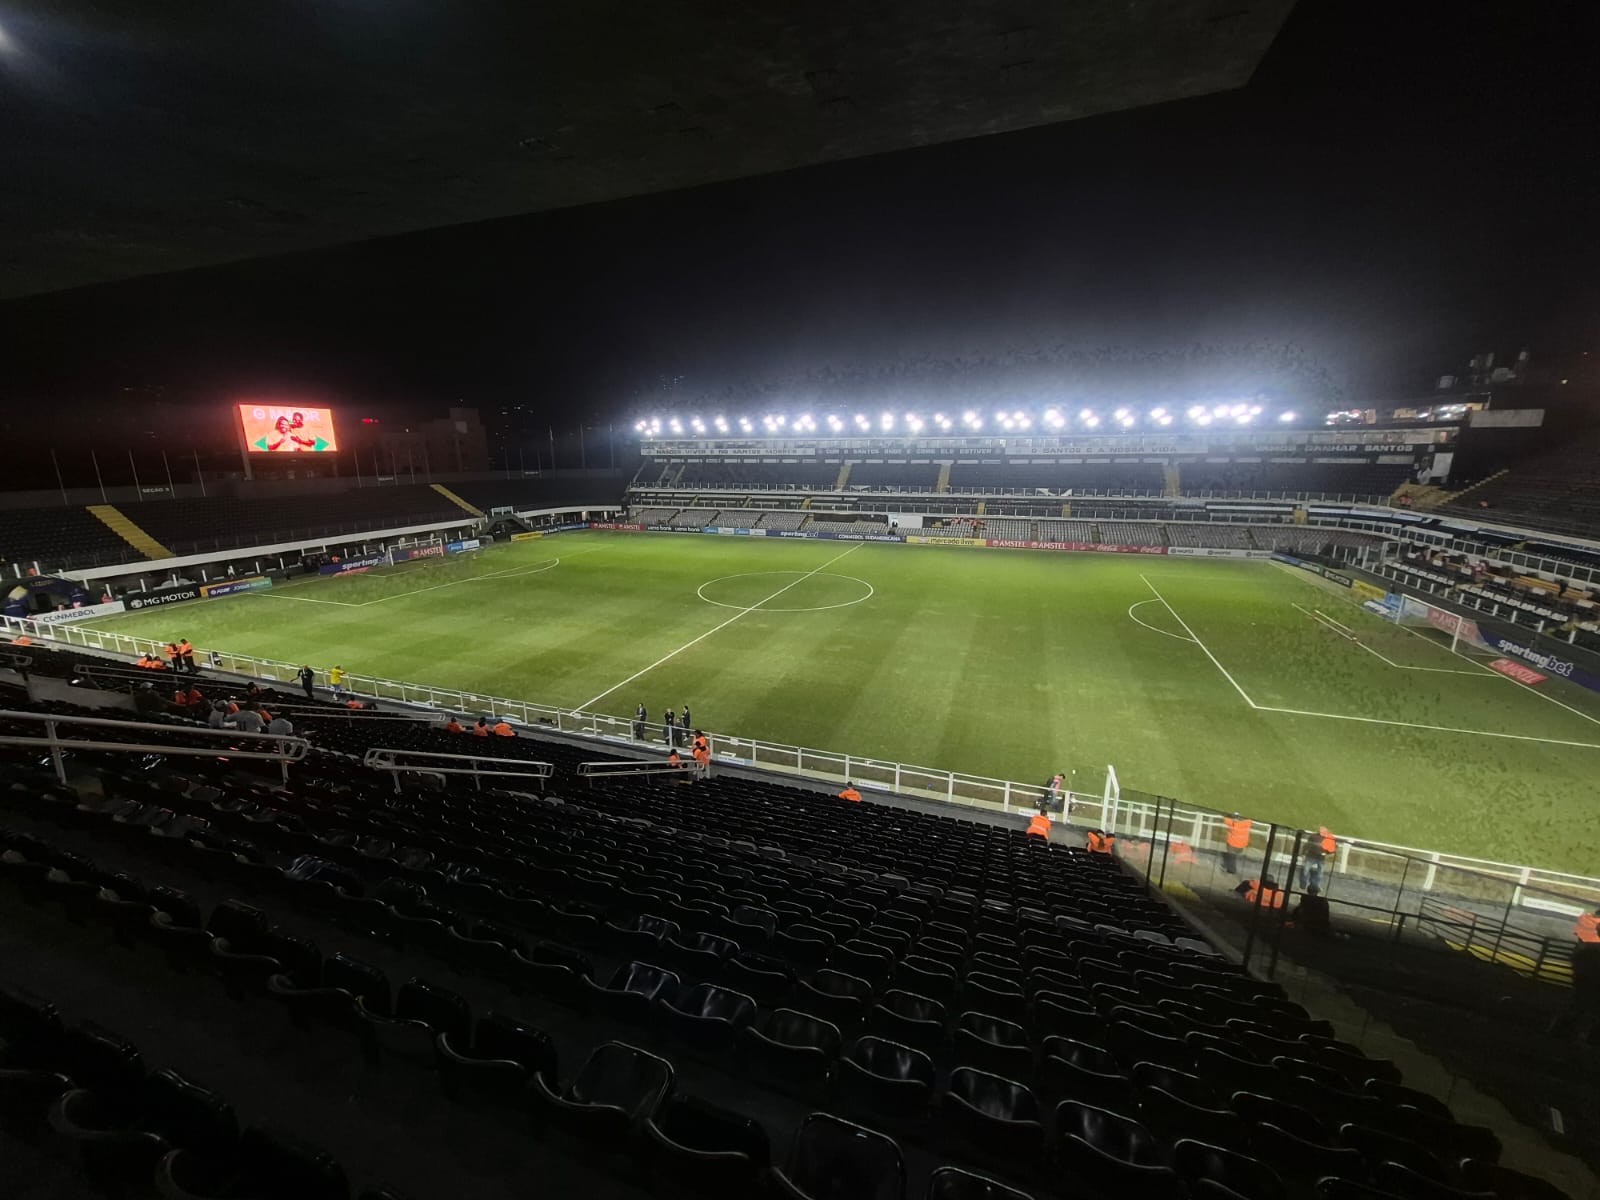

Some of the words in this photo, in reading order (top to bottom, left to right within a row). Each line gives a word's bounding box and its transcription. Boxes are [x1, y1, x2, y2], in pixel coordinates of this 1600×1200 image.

[1364, 444, 1414, 452] SANTOS
[999, 540, 1026, 548] AMSTEL
[143, 598, 160, 606] MG
[161, 591, 196, 604] MOTOR
[1498, 639, 1574, 677] sportingbet
